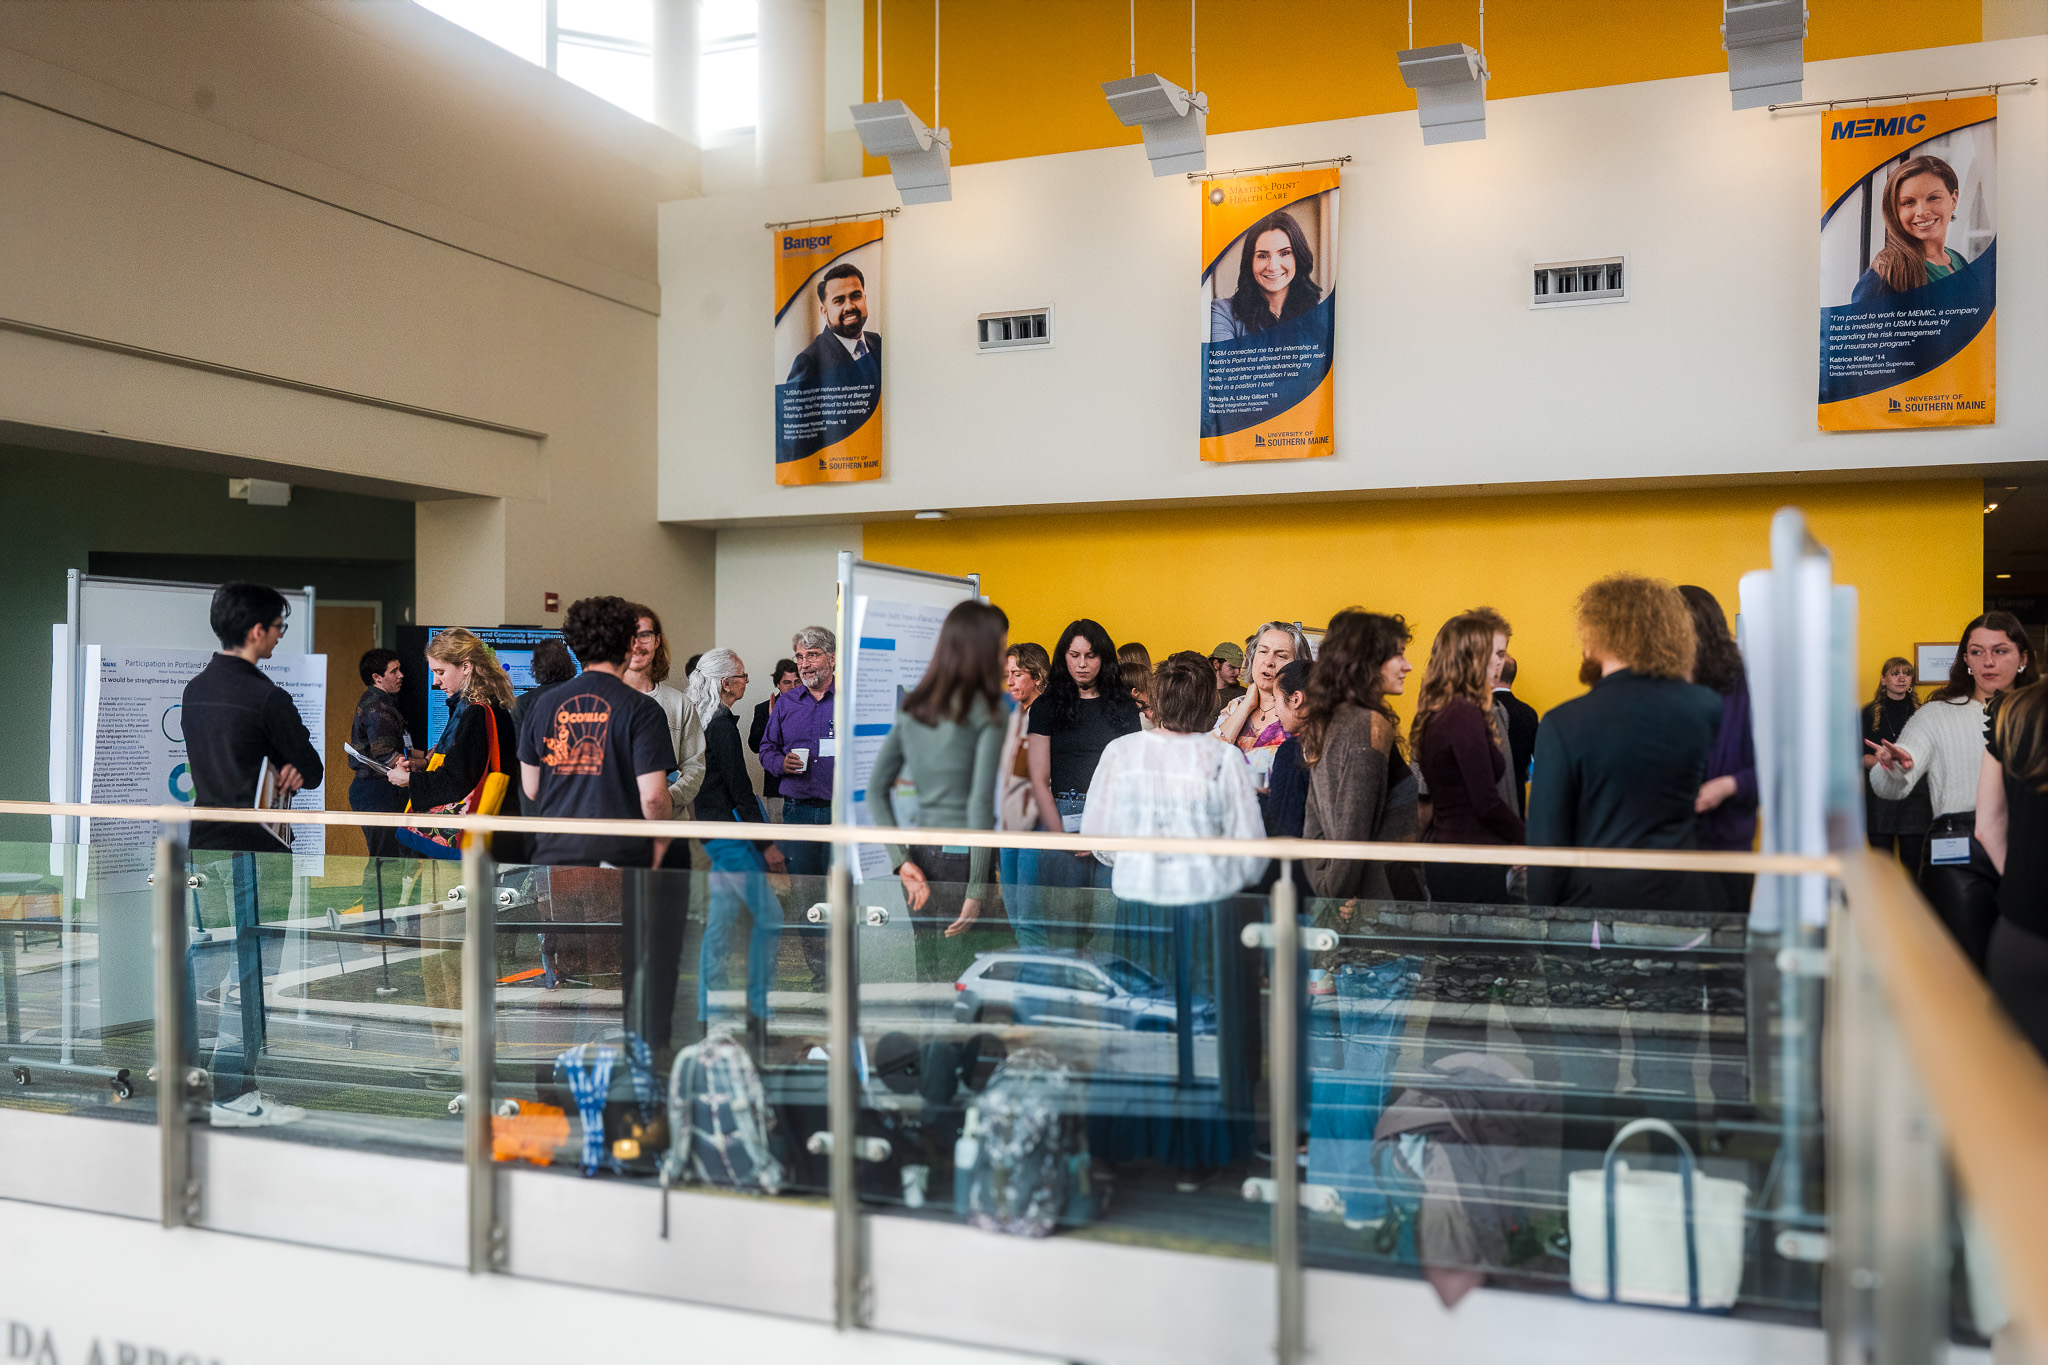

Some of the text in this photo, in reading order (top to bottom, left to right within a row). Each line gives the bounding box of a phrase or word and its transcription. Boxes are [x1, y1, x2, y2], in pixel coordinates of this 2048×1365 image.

[1831, 114, 1926, 140] MEMIC
[784, 235, 832, 250] Bangor
[1846, 314, 1867, 322] proud
[1945, 307, 1979, 316] company
[1852, 322, 1883, 330] investing
[1830, 333, 1865, 342] expanding
[1894, 329, 1941, 338] management
[1227, 348, 1256, 356] connected
[1253, 371, 1282, 380] graduation
[1905, 401, 1986, 412] SOUTHERN MAINE
[1268, 436, 1329, 446] SOUTHERN MAINE
[864, 460, 879, 468] MAINE
[125, 660, 165, 668] Participation
